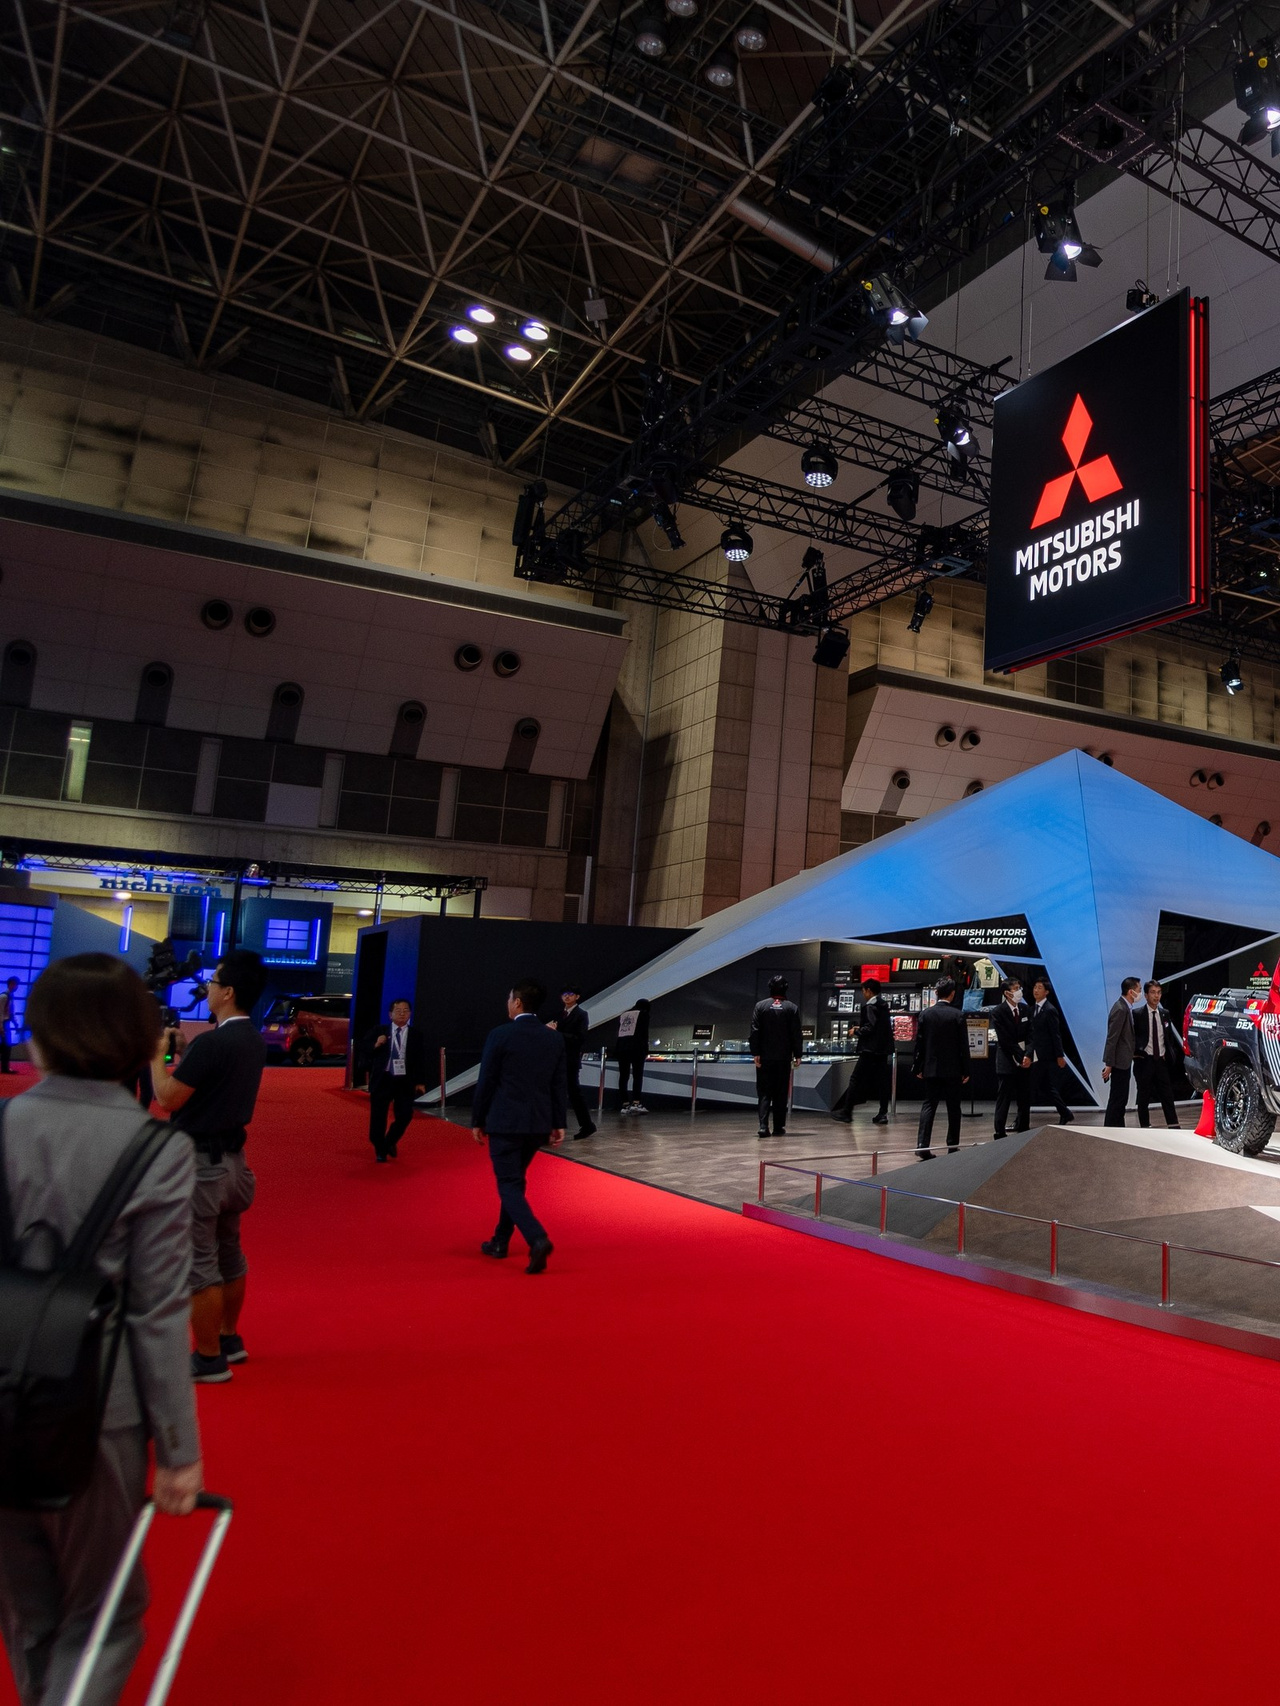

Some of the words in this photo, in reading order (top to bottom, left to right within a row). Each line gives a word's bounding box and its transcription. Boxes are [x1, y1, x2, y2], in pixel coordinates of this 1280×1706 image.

[1015, 499, 1140, 576] MITSUBISHI
[1029, 540, 1122, 601] MOTORS
[100, 871, 223, 898] nichicon
[930, 928, 986, 937] MITSUBISHI
[986, 928, 1027, 936] MOTORS
[968, 937, 1027, 945] COLLECTION
[263, 954, 316, 965] nichicon
[1235, 1021, 1255, 1030] DEX
